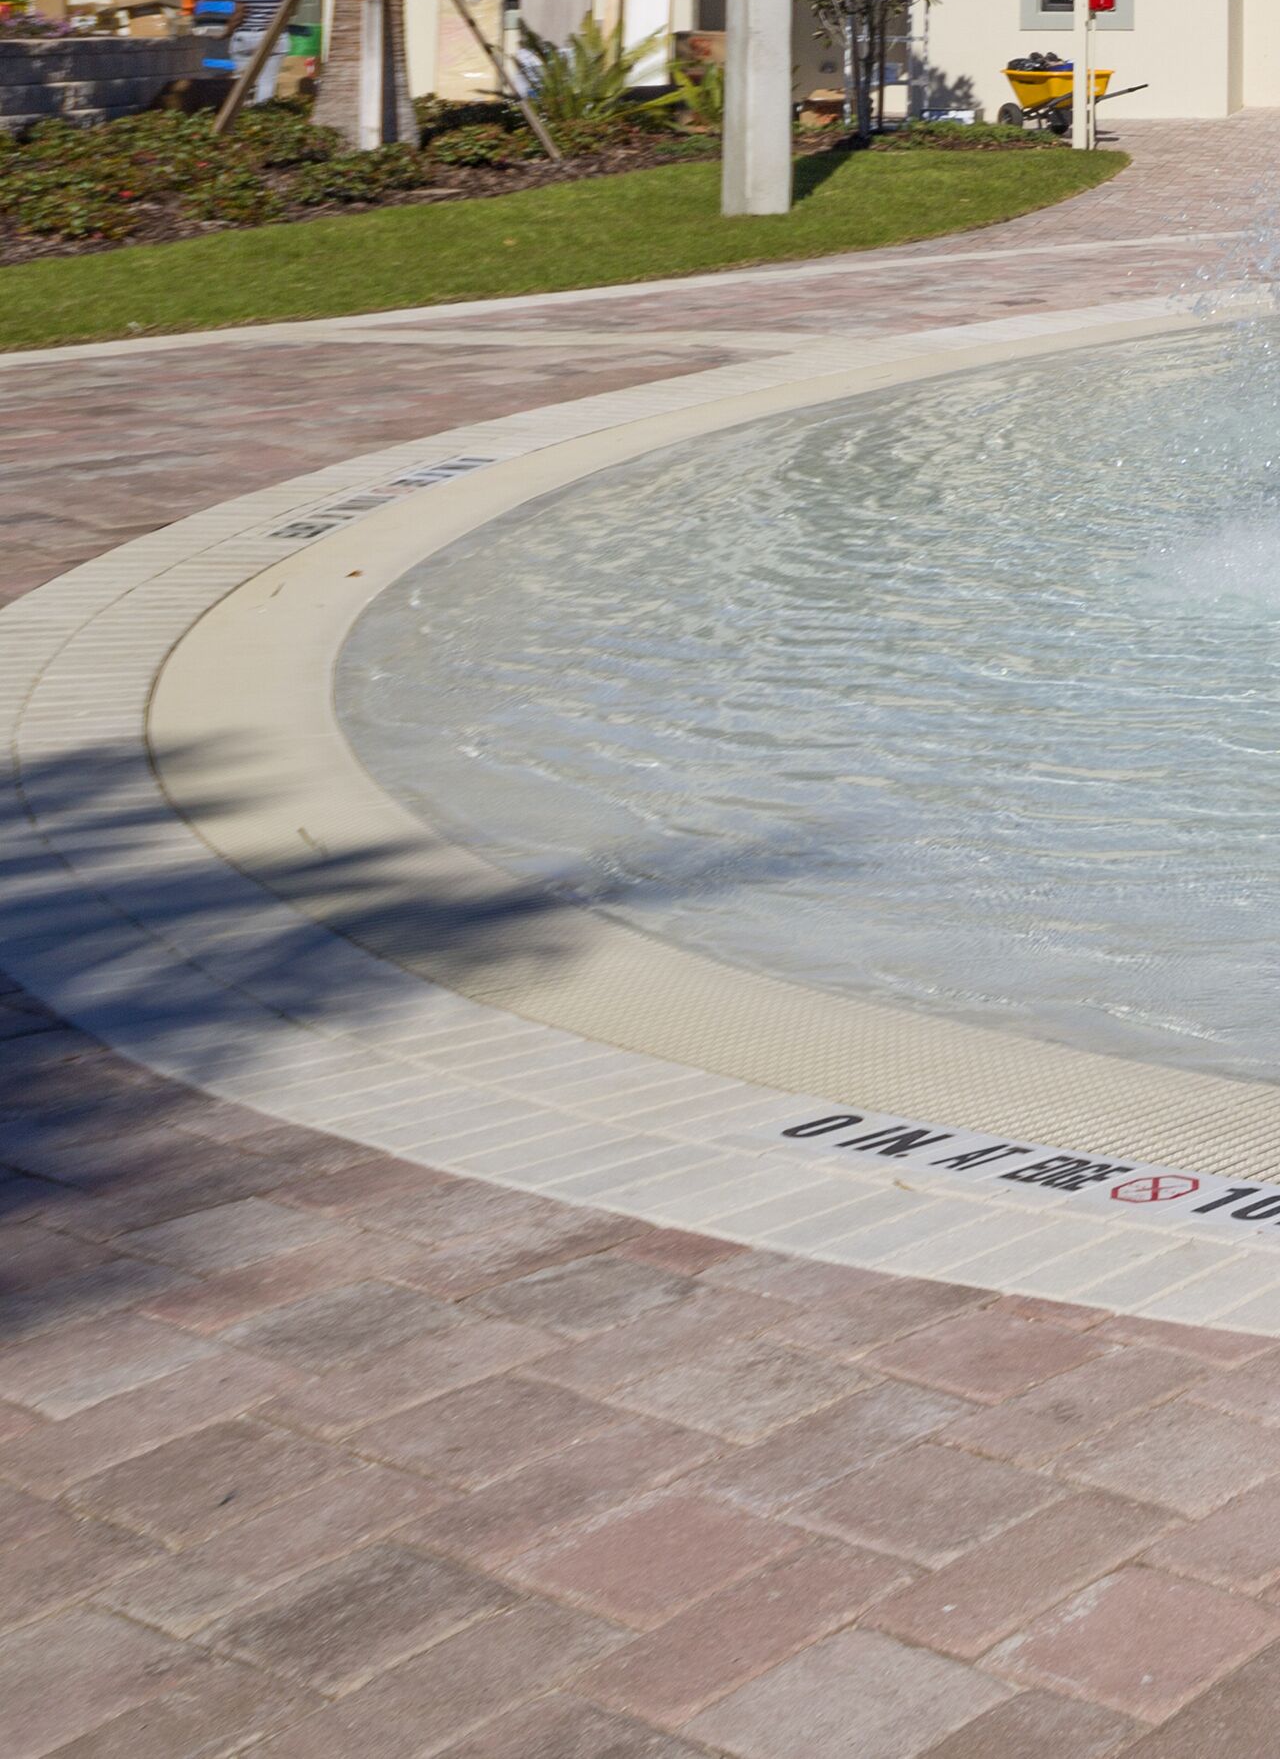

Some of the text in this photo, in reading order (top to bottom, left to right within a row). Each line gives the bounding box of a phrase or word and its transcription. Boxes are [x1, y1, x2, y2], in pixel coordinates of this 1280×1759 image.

[834, 1126, 955, 1158] IN.
[928, 1143, 1034, 1171] AT
[998, 1155, 1134, 1191] EDGE
